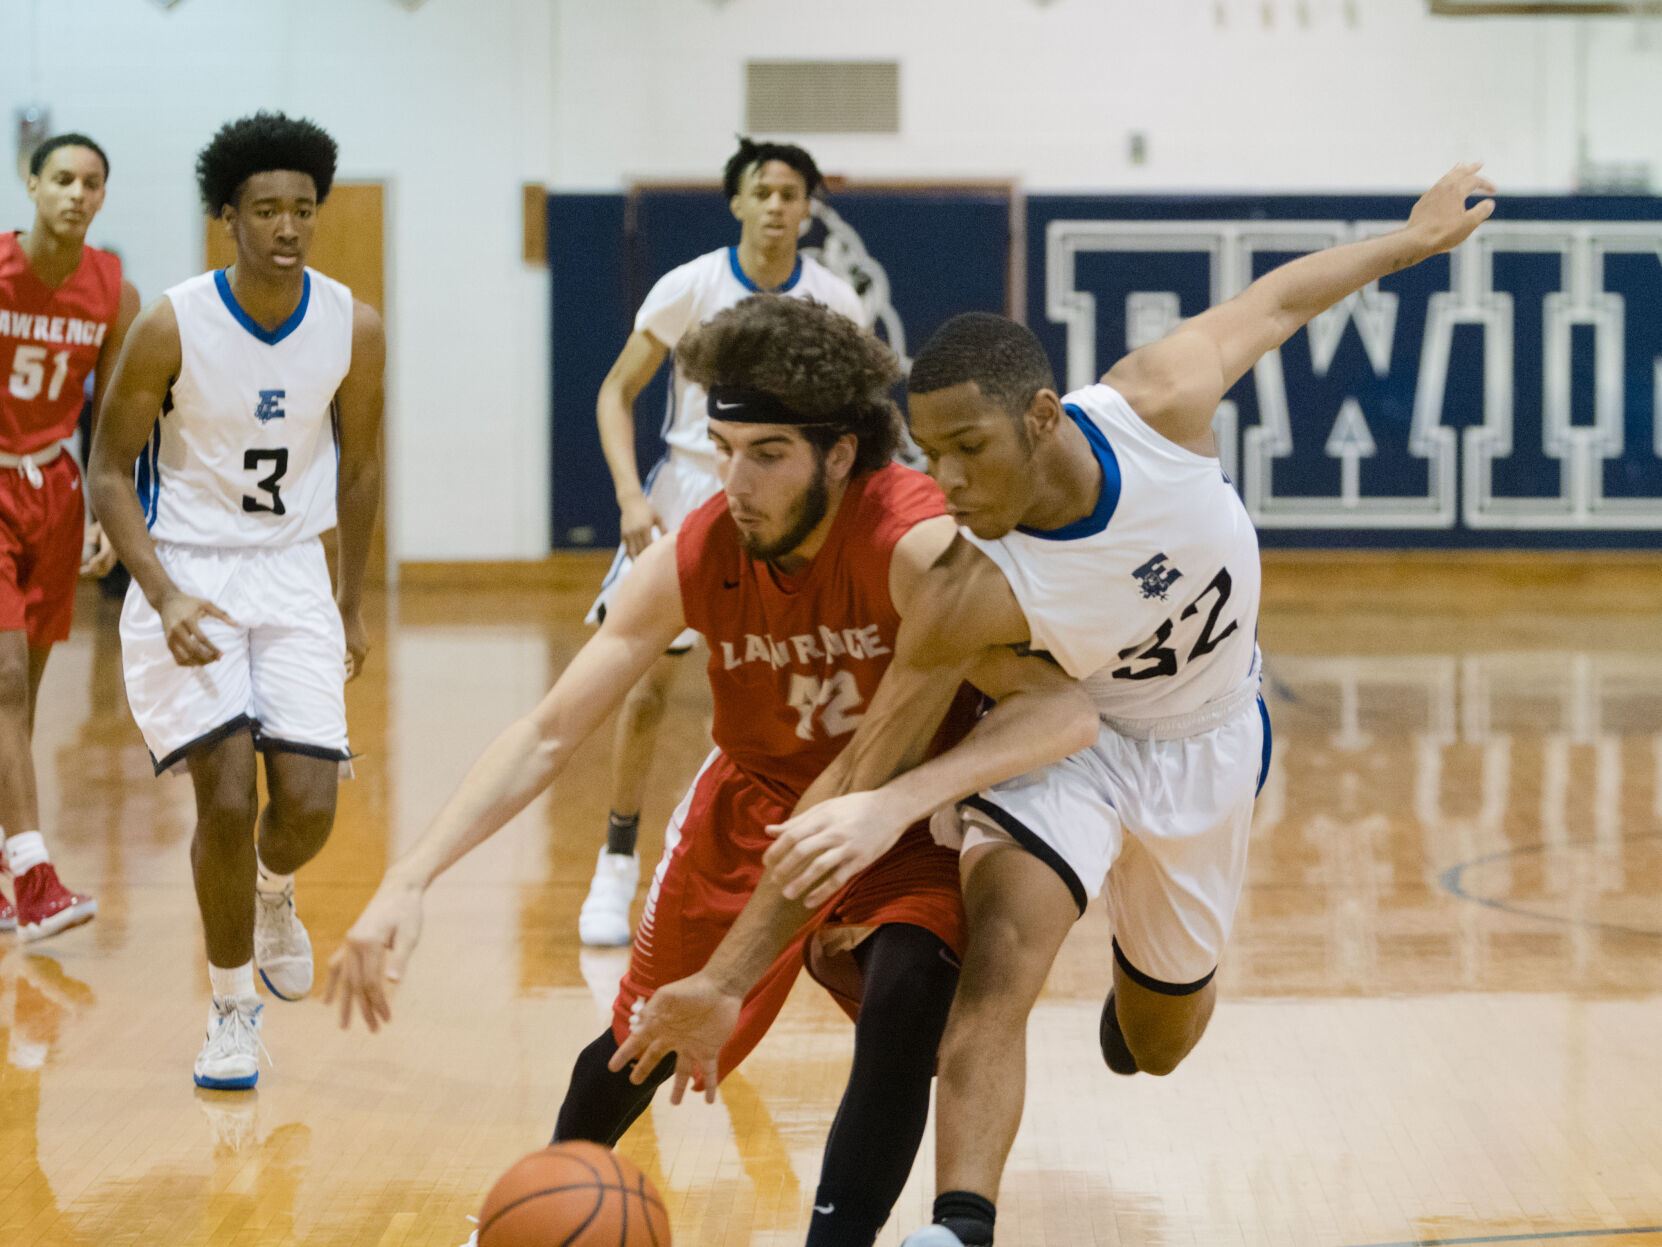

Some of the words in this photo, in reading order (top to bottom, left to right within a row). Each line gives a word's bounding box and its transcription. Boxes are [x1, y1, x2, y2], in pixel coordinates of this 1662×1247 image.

[8, 345, 70, 402] 51
[242, 448, 288, 515] 3
[720, 623, 892, 671] LAWRNCE
[1112, 565, 1239, 681] 32
